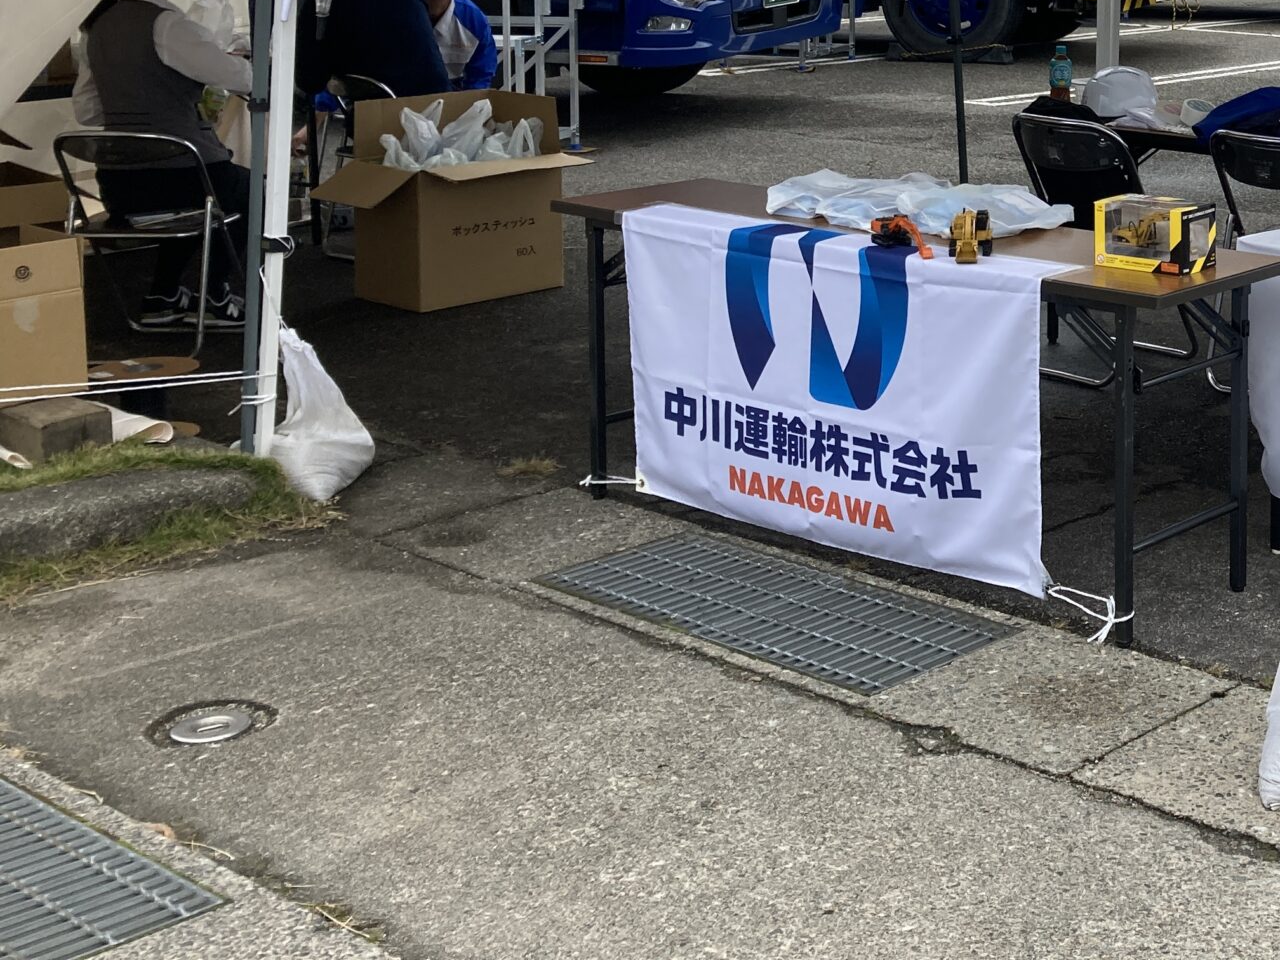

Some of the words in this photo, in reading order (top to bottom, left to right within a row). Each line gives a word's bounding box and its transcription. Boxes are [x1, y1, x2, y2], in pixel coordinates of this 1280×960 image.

[452, 217, 536, 237] ボックスティッシュ
[663, 386, 982, 500] 中川運輸株式会社
[728, 465, 895, 533] NAKAGAWA
